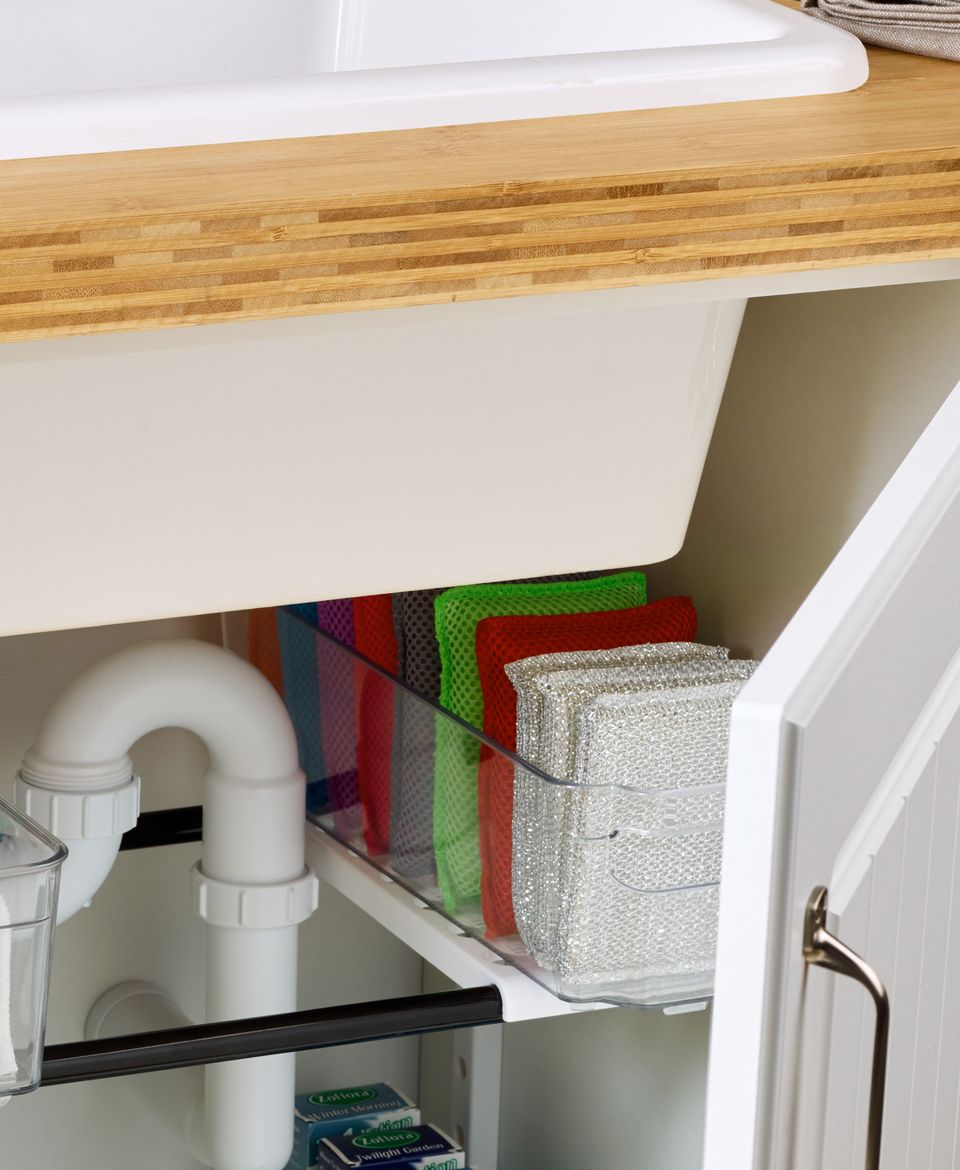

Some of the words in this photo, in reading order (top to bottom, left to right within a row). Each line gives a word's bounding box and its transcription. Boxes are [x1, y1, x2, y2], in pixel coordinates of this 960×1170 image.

[316, 1089, 370, 1103] Zoflora
[307, 1108, 348, 1121] Winter
[350, 1100, 402, 1114] Morning
[362, 1132, 415, 1146] Zoflora
[355, 1148, 401, 1161] Twilight
[403, 1142, 445, 1154] Garden
